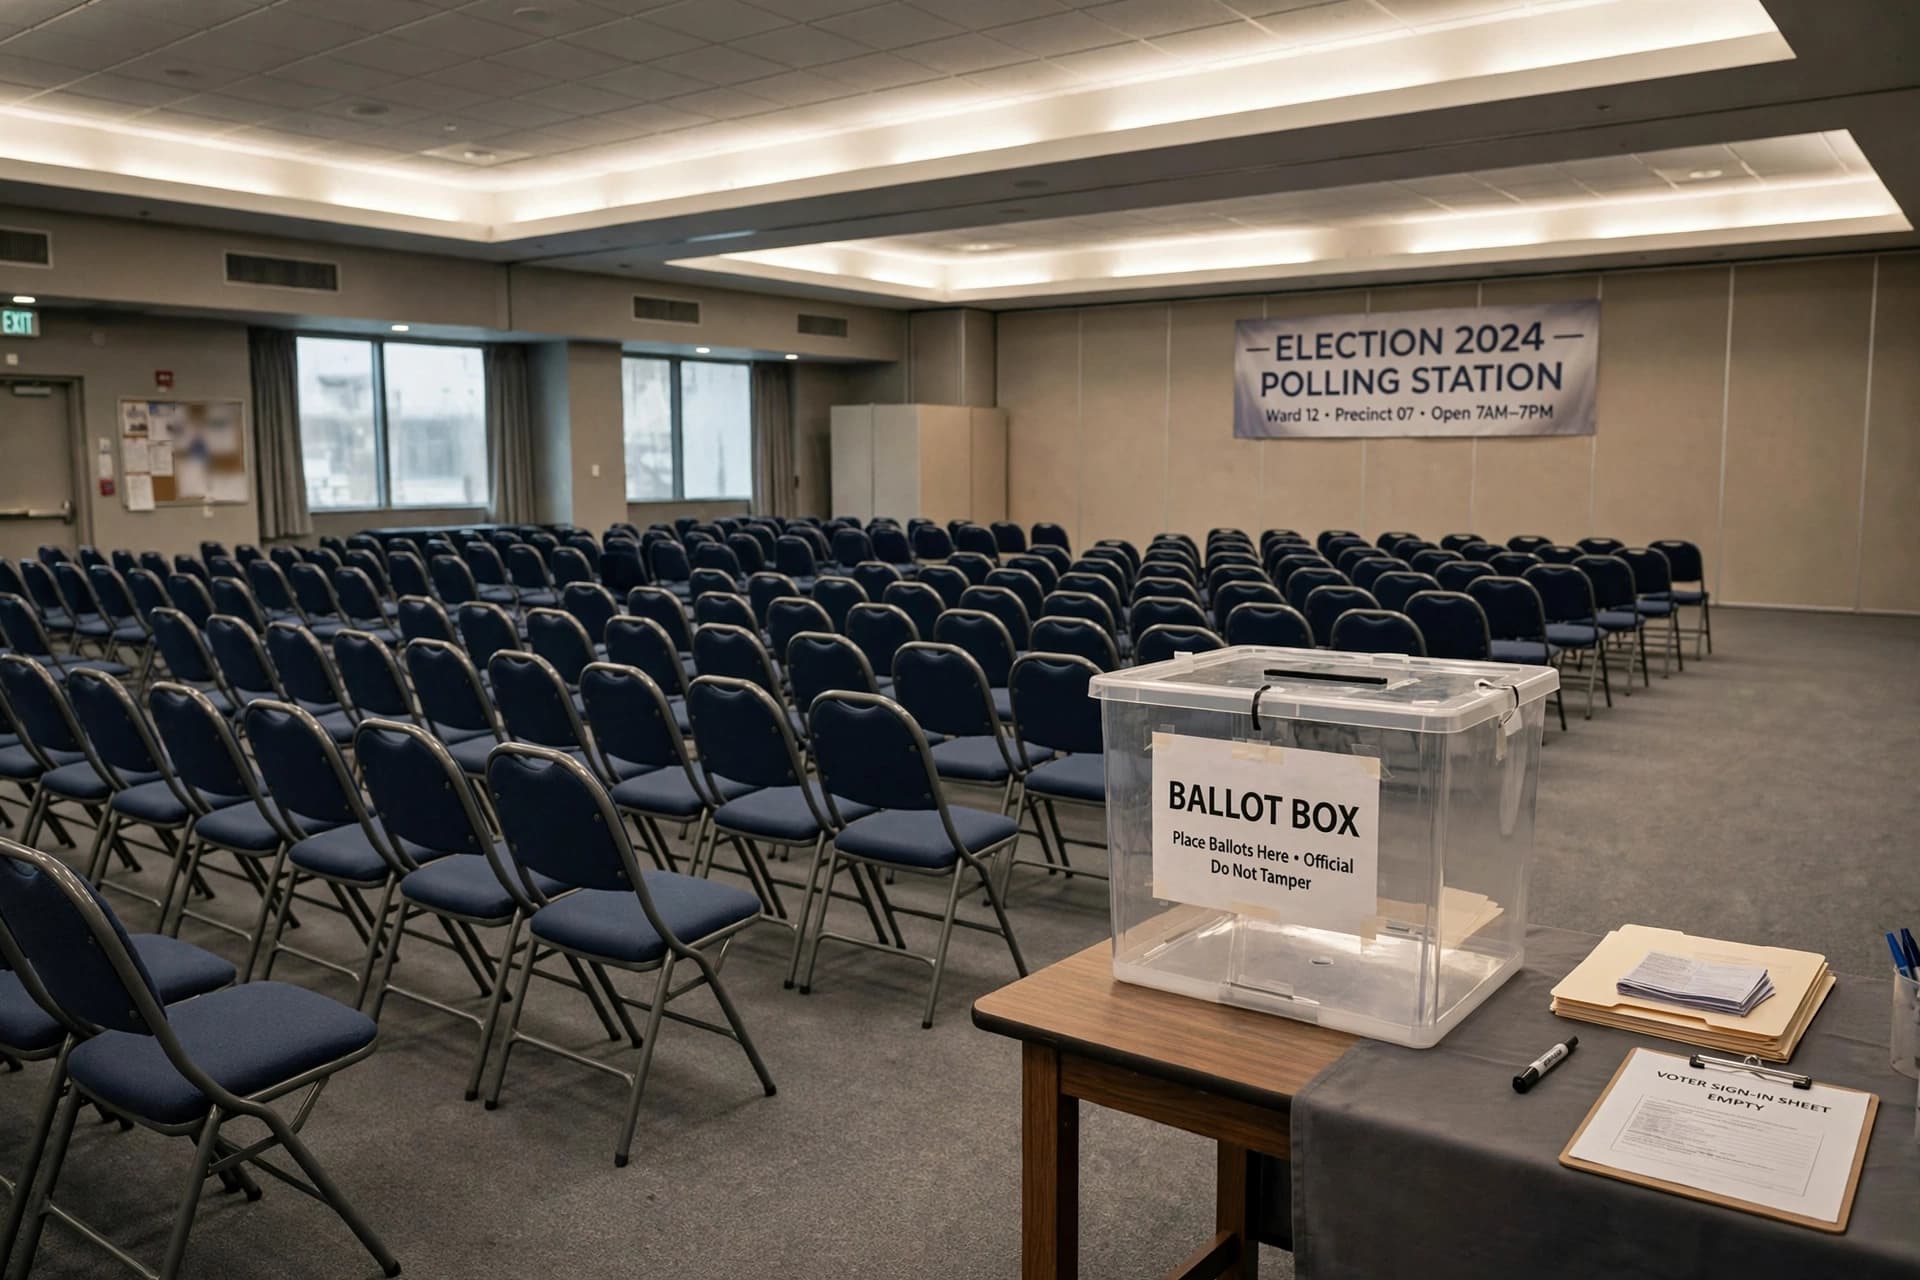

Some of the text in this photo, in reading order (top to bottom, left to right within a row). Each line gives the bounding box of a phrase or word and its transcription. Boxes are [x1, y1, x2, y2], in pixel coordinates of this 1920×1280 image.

[3, 310, 33, 335] EXIT
[1276, 321, 1545, 361] ELECTION 2024
[1261, 361, 1563, 397] POLLING STATION
[1266, 407, 1302, 422] Ward
[1306, 408, 1320, 422] 12
[1335, 406, 1393, 421] Precinct
[1397, 407, 1415, 421] 07
[1431, 405, 1471, 423] Open
[1169, 780, 1360, 838] BALLOT BOX
[1173, 831, 1354, 874] Place Ballots Here Official
[1211, 859, 1312, 890] Do Not Tamper
[1657, 1071, 1832, 1113] VOTER SIGN-IN SHEET
[1707, 1093, 1766, 1112] EMPTY
